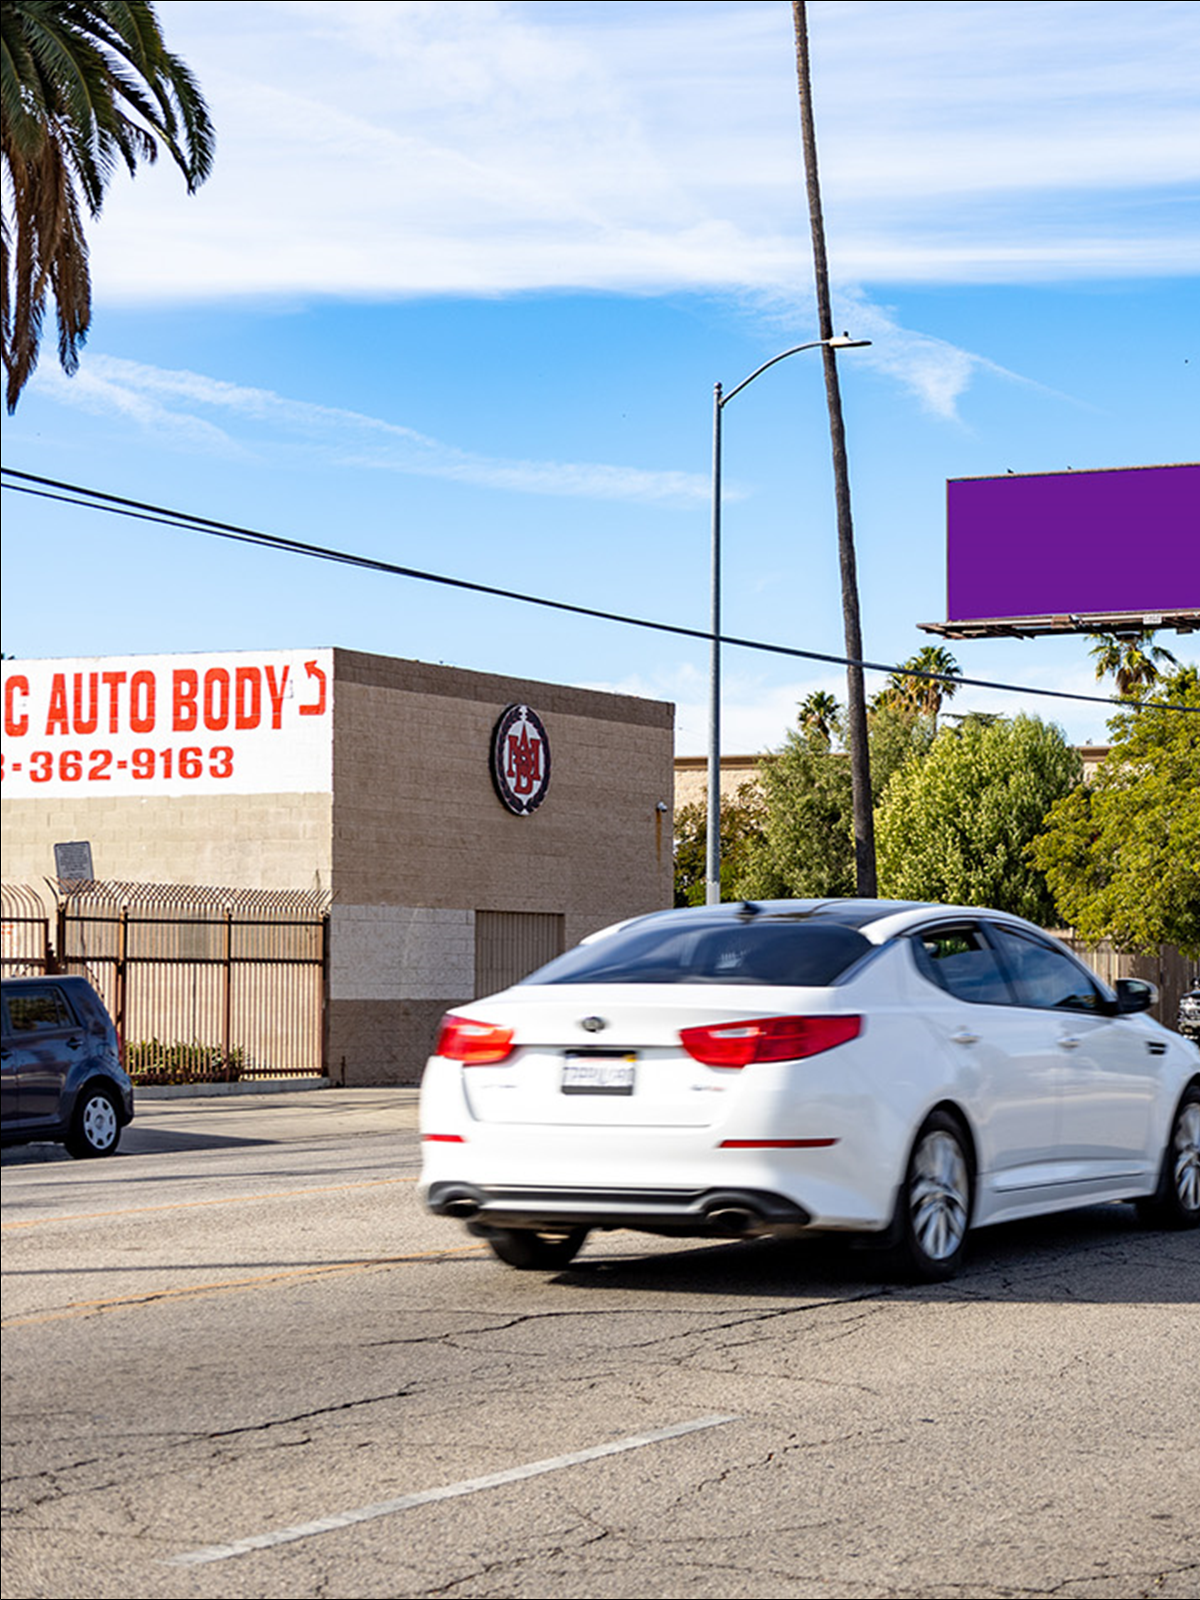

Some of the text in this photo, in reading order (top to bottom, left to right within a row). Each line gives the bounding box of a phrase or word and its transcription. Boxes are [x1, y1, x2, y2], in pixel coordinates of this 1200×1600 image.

[3, 664, 291, 738] C AUTO BODY
[1, 745, 234, 783] -362-9163
